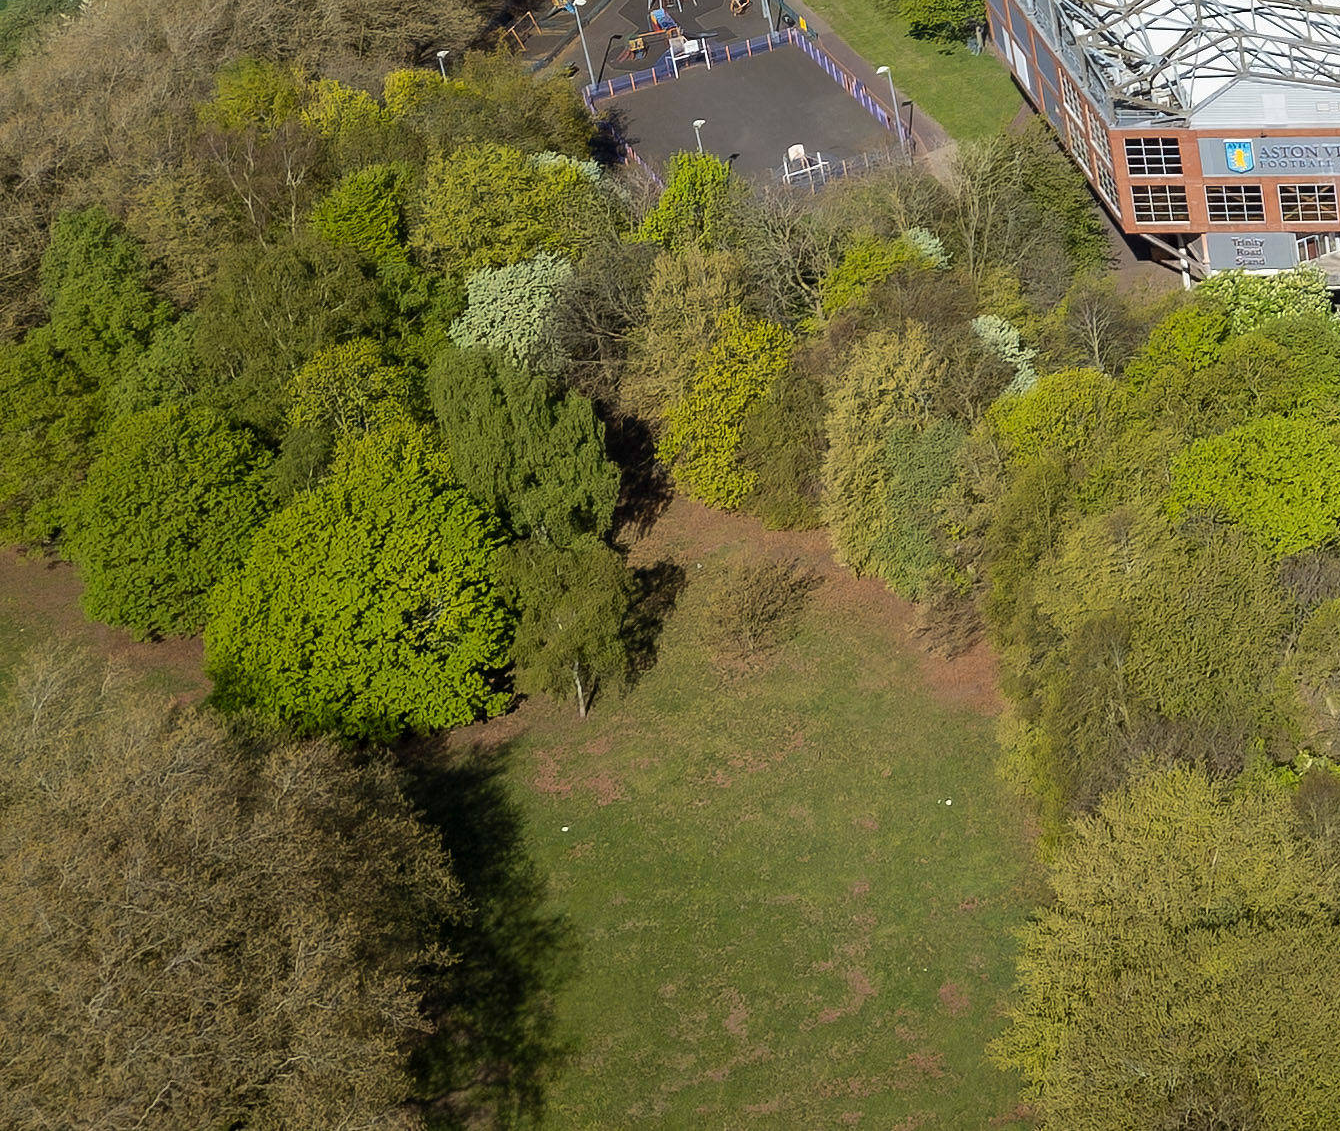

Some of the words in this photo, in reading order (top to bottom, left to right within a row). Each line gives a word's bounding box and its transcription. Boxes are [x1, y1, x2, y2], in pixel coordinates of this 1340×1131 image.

[1259, 145, 1318, 159] ASTON
[1259, 159, 1332, 169] FOOTBALL
[1231, 237, 1265, 248] Trinity
[1236, 248, 1263, 256] Road
[1235, 257, 1266, 266] Stand
